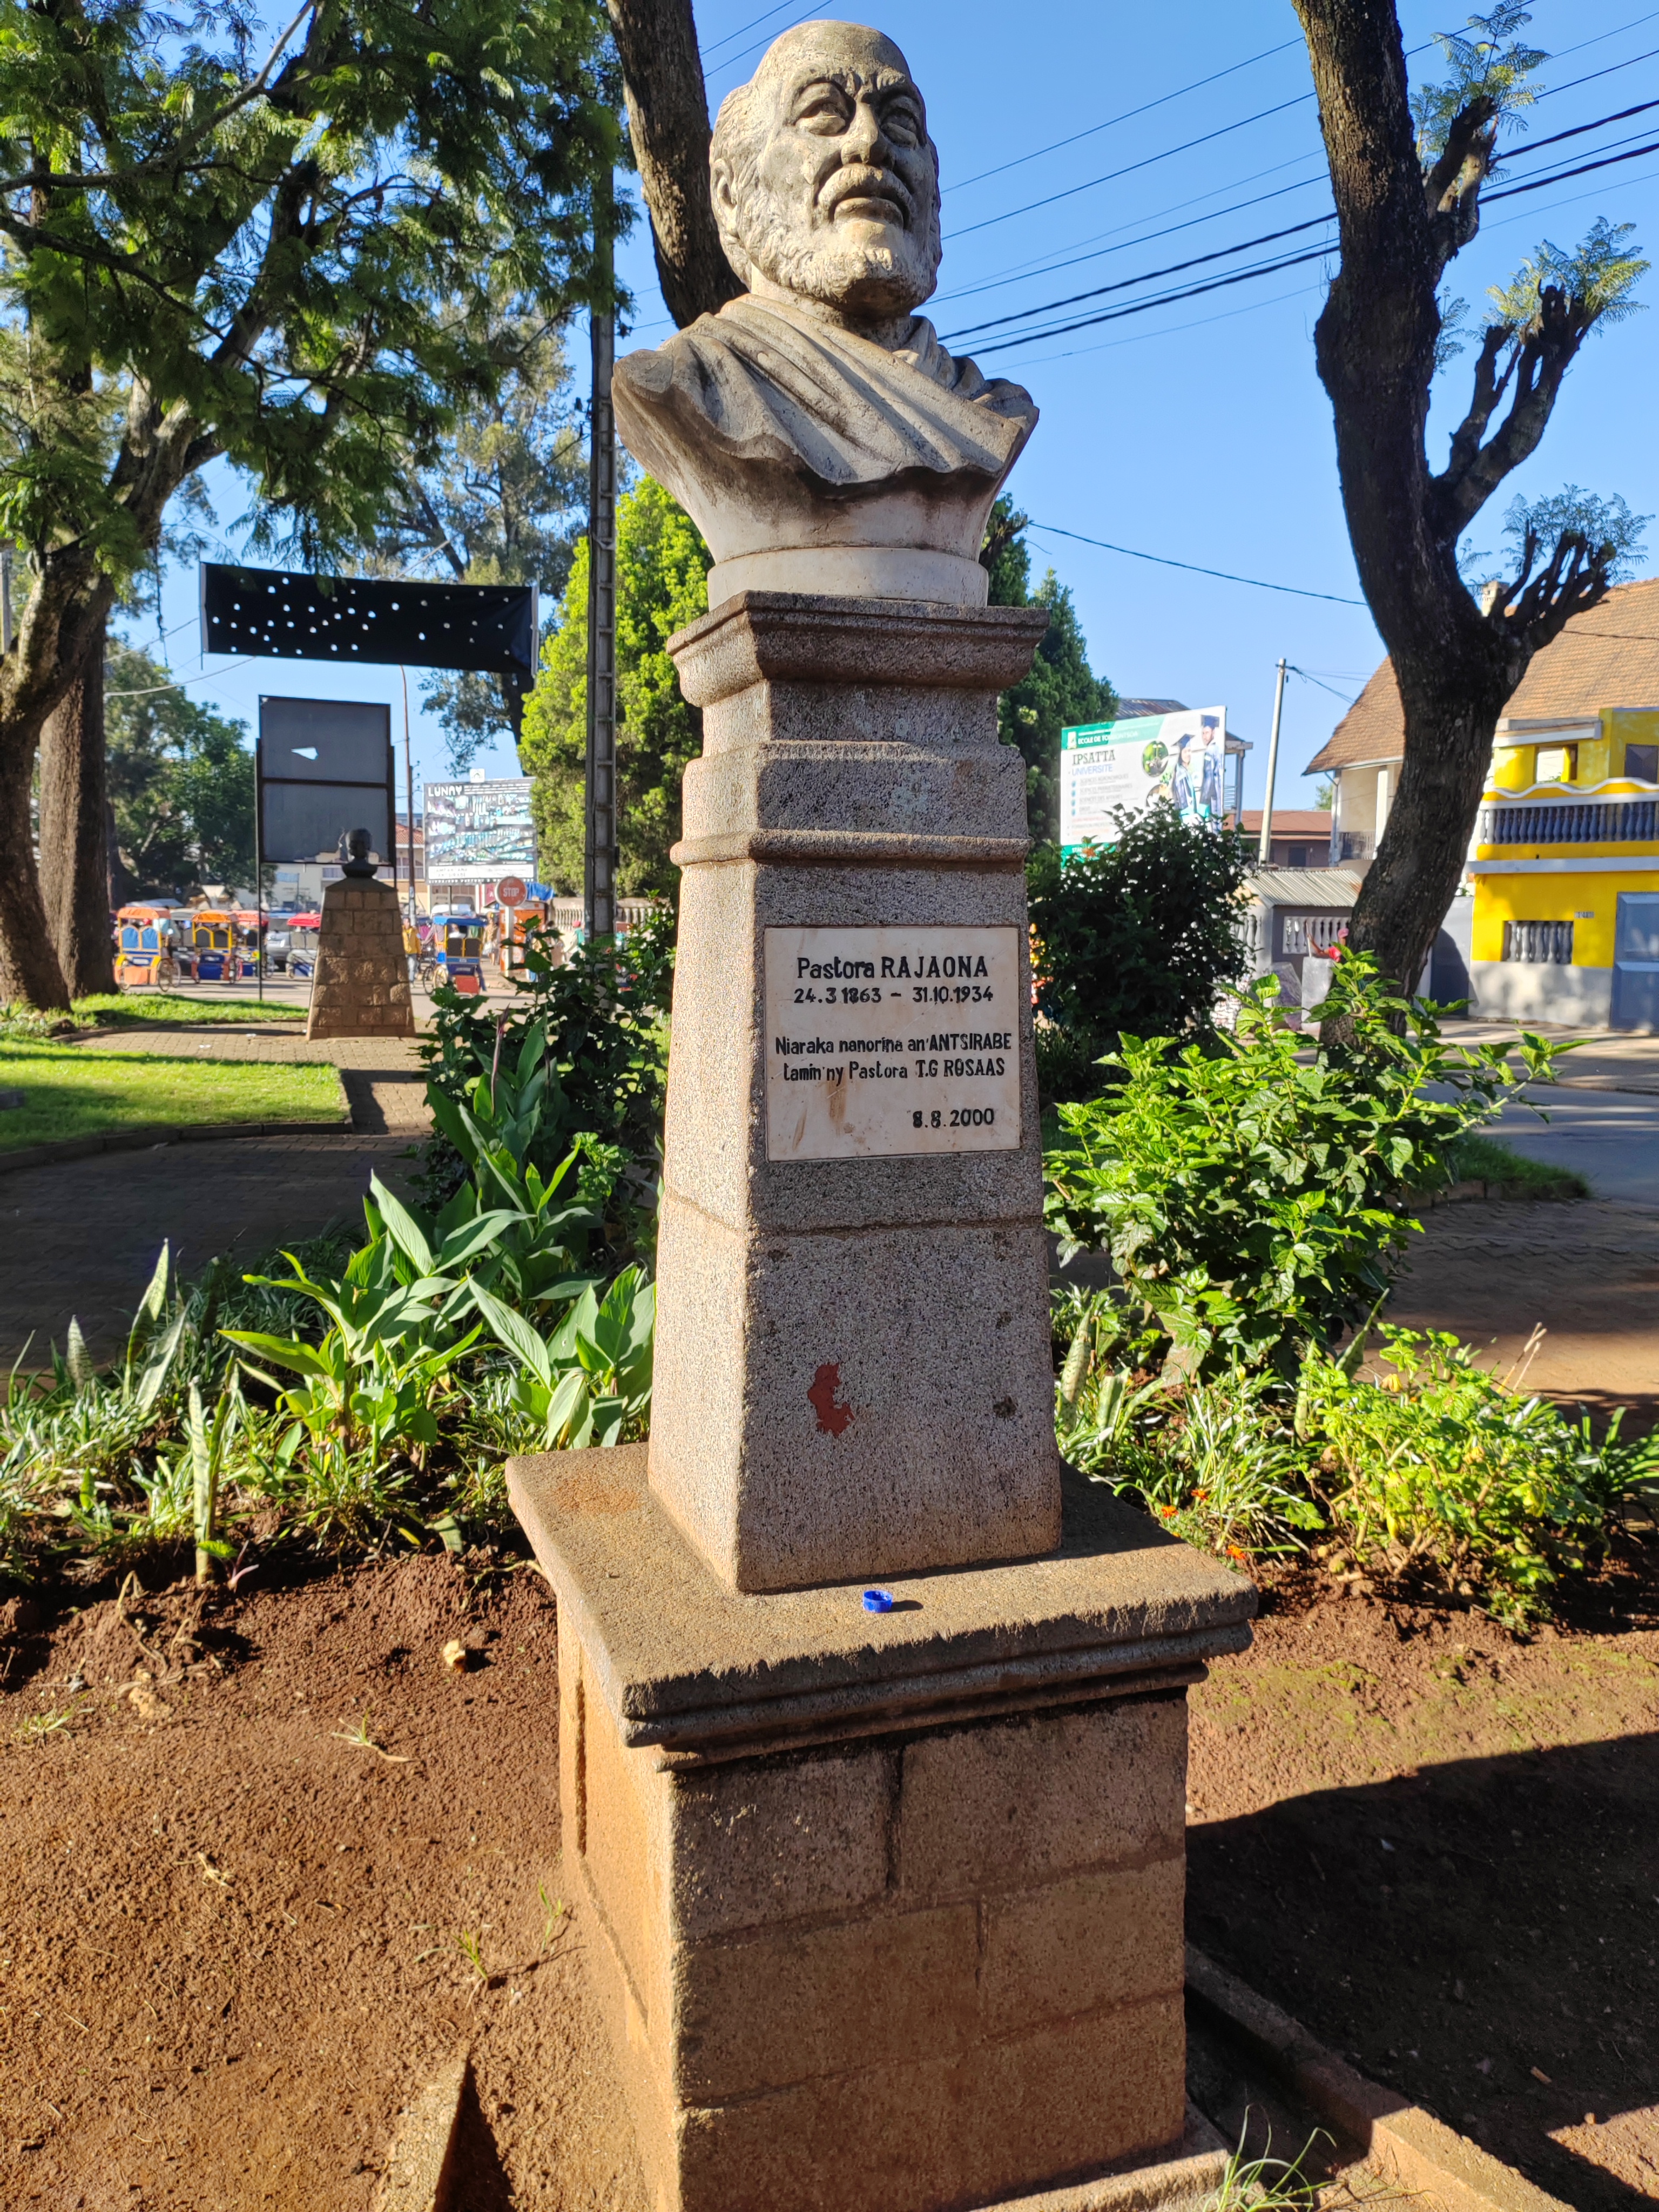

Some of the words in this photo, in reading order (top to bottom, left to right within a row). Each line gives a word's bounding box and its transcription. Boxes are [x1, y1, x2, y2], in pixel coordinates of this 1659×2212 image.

[1073, 750, 1116, 765] IPSATTA
[428, 786, 462, 797] LUNAY
[503, 888, 520, 898] STOP
[797, 956, 875, 979] Pastora
[881, 955, 988, 979] RAJAONA
[913, 986, 994, 1004] 31.10.1934
[776, 1036, 834, 1055] Niaraka
[839, 1038, 903, 1053] nanorina
[908, 1033, 1012, 1052] an'ANTSIRABE
[784, 1062, 844, 1087] tamin'ny
[849, 1061, 908, 1079] Pastora
[916, 1060, 939, 1078] T.G
[944, 1058, 1005, 1077] ROSAAS
[913, 1108, 995, 1129] 8.8.2000
